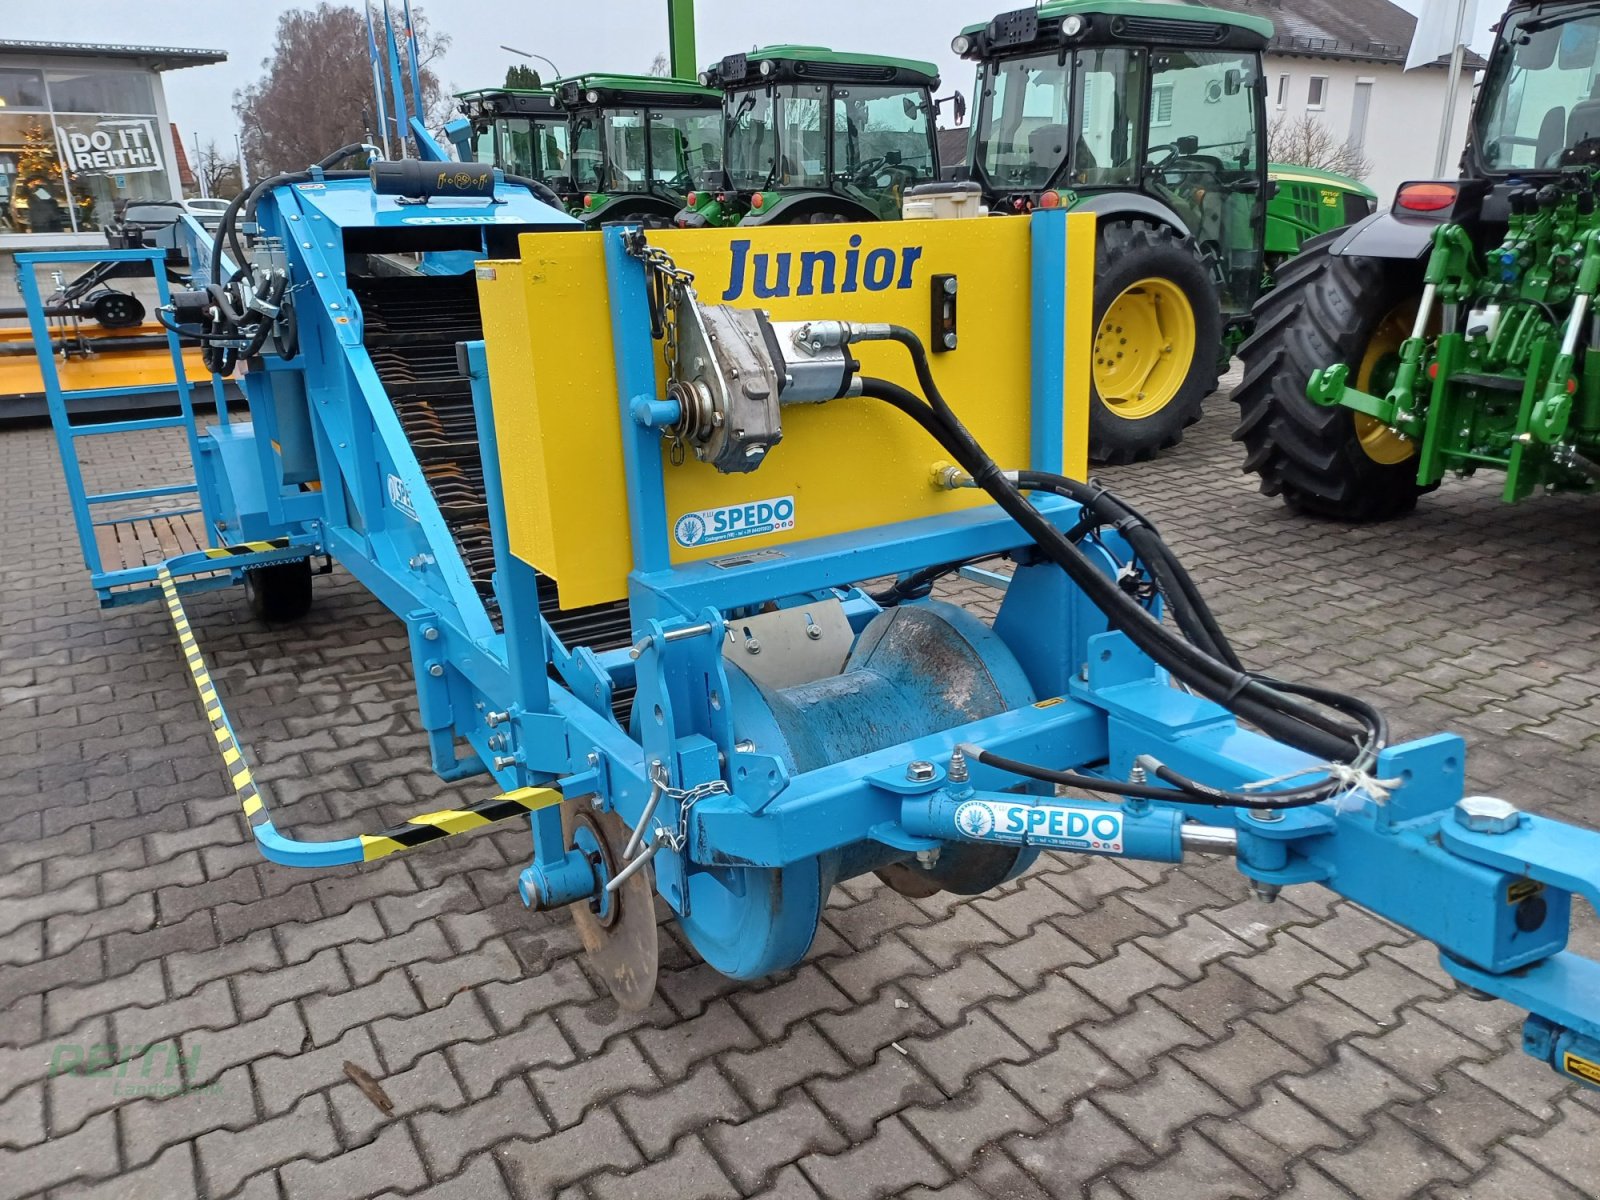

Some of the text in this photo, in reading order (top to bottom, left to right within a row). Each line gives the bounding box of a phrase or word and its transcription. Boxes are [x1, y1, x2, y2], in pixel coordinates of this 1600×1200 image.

[69, 127, 144, 153] DO IT
[74, 147, 152, 169] REITH!
[721, 233, 923, 301] Junior
[713, 499, 793, 532] SPEDO
[1006, 807, 1120, 841] SPEDO
